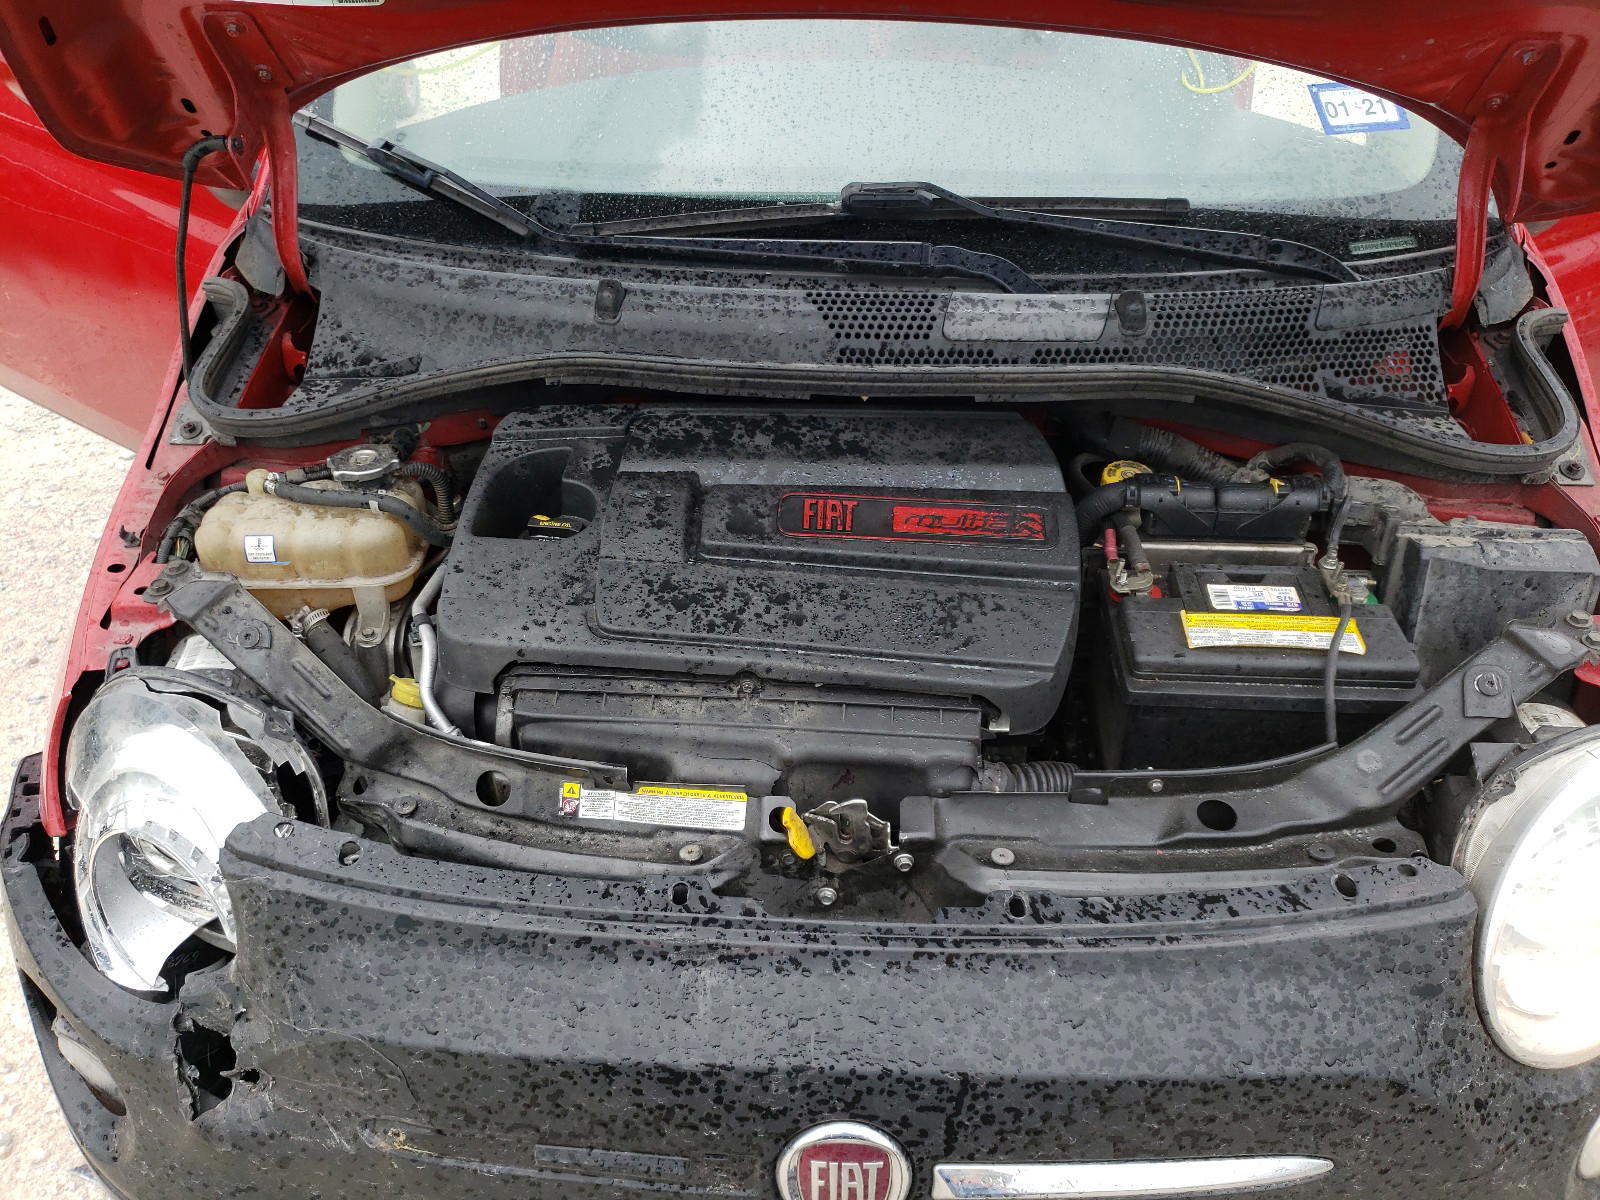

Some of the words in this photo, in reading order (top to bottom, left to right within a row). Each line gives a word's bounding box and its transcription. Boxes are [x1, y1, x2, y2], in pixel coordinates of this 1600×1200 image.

[1324, 101, 1350, 118] 01
[1361, 98, 1387, 115] 21
[802, 498, 858, 532] FIAT
[810, 1160, 884, 1200] FIAT
